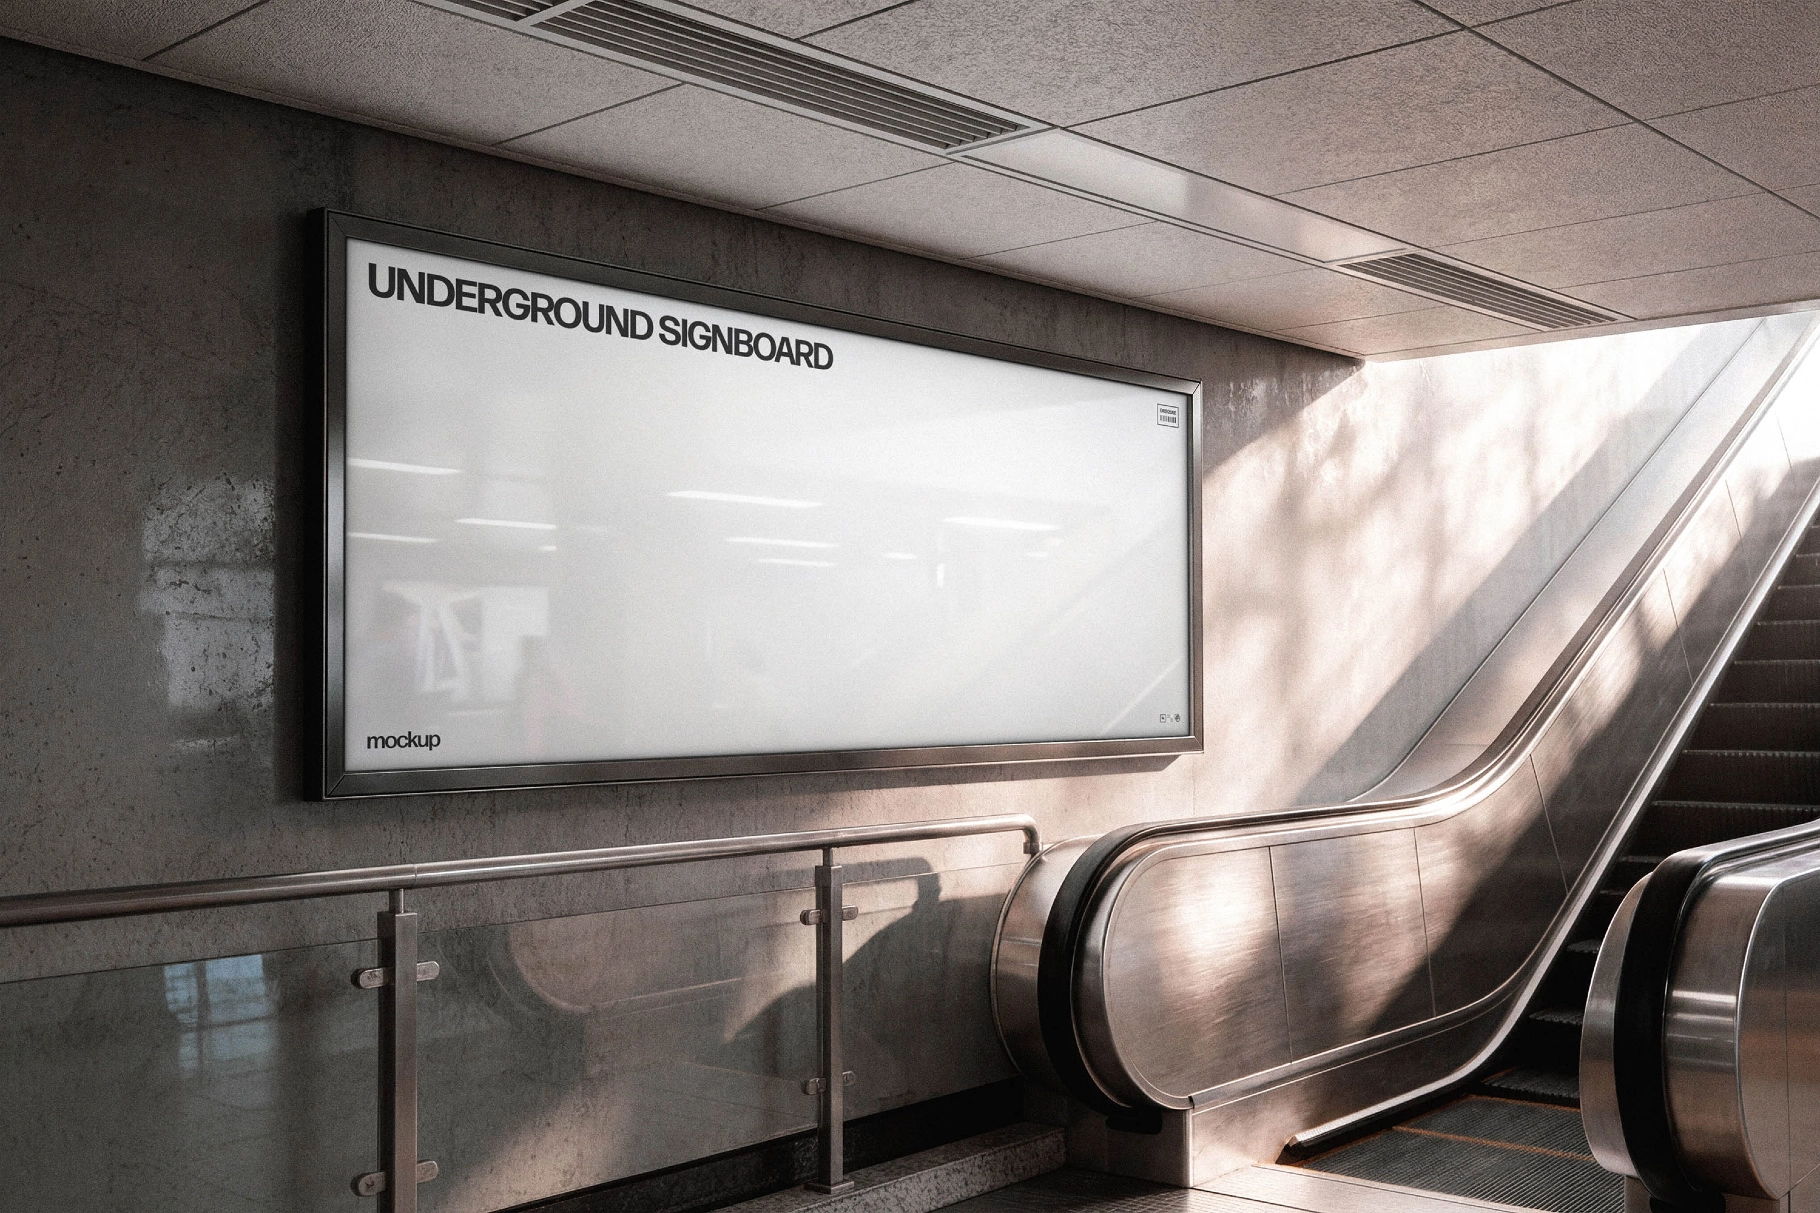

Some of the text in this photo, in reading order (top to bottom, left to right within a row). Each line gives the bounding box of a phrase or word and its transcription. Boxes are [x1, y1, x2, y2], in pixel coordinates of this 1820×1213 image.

[367, 262, 834, 371] UNDERGROUND SIGNBOARD
[366, 730, 442, 751] mockup
